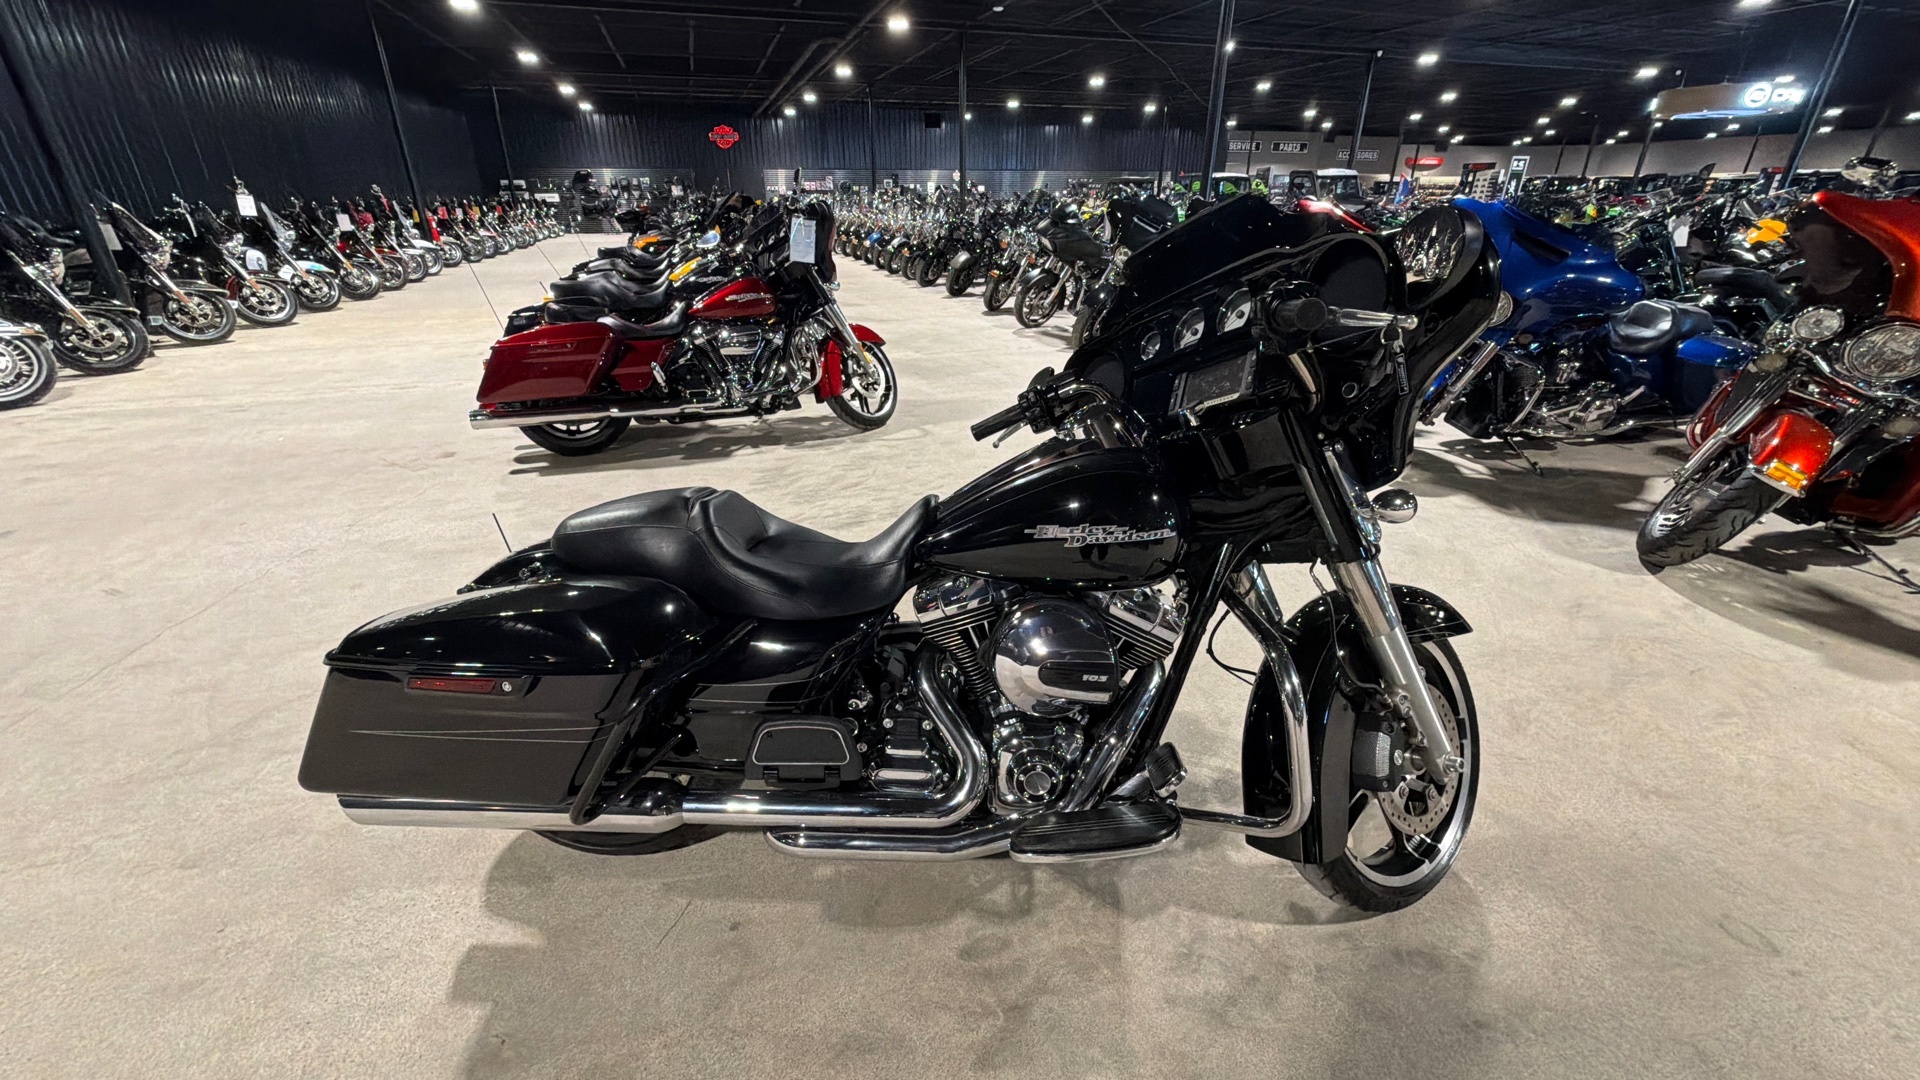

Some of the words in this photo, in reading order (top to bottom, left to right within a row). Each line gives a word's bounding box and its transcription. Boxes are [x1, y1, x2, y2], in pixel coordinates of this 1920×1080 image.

[1279, 143, 1301, 152] PARTS
[1338, 151, 1378, 159] ACCSORIES
[1064, 529, 1177, 548] Davidson
[1082, 674, 1109, 682] 103
